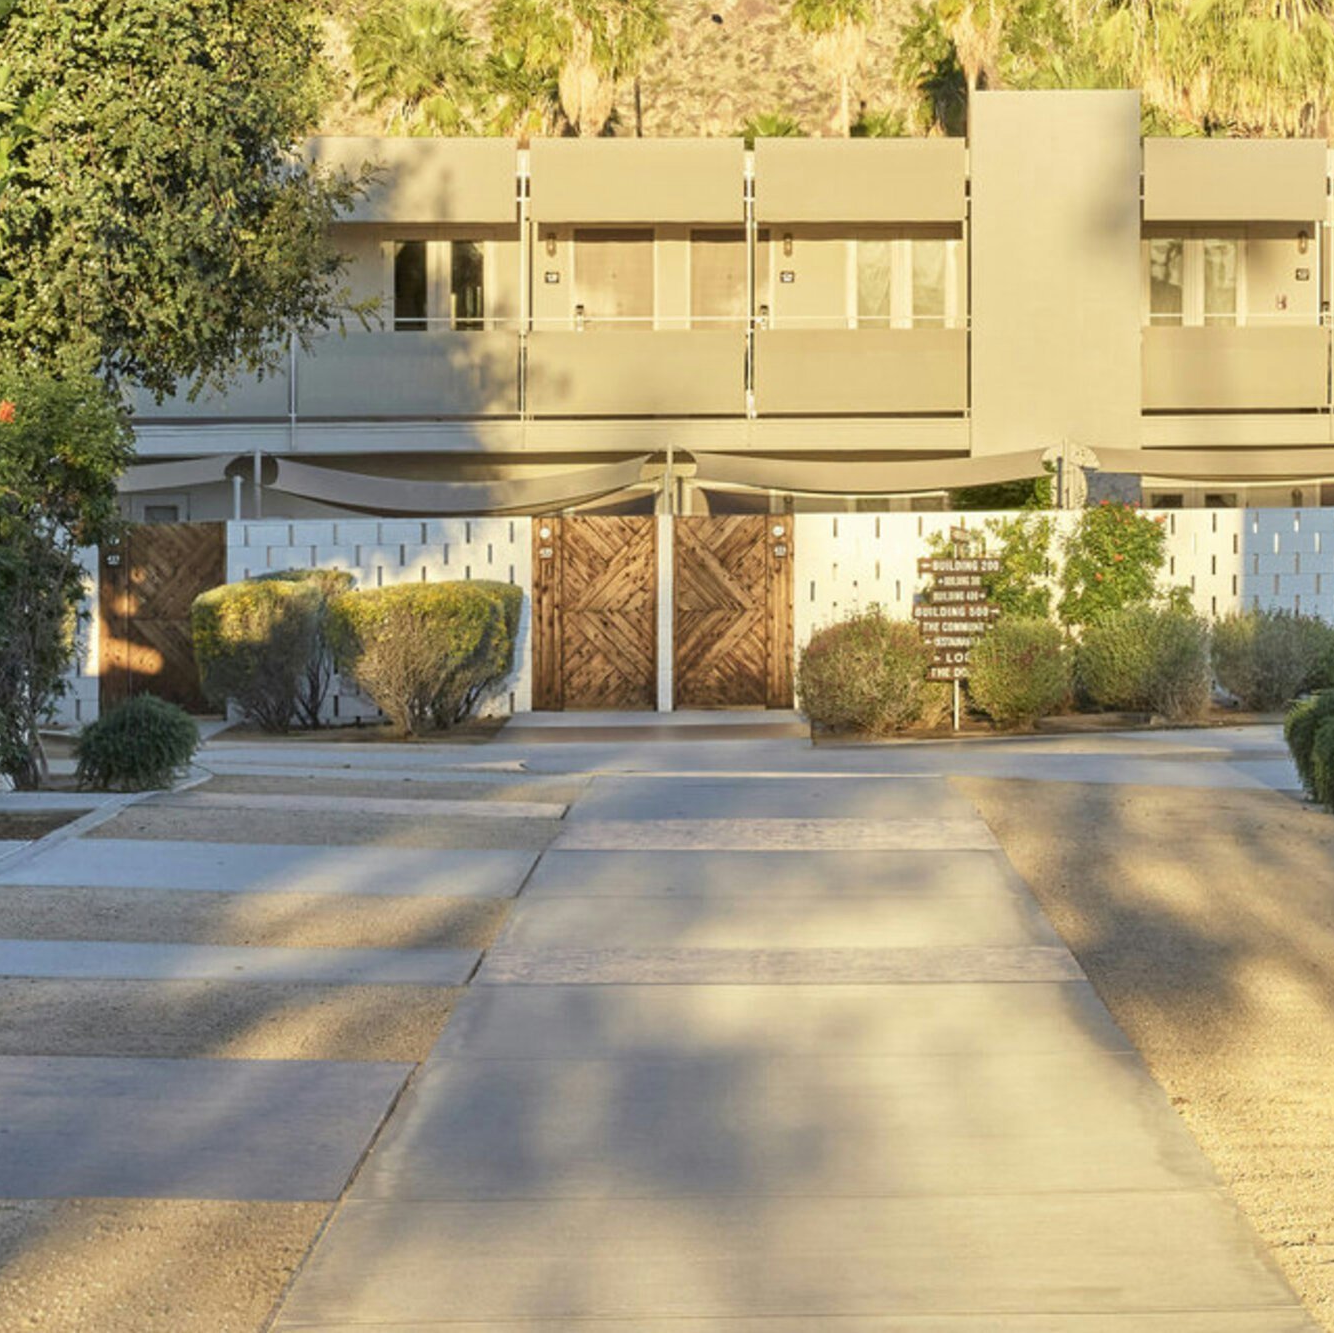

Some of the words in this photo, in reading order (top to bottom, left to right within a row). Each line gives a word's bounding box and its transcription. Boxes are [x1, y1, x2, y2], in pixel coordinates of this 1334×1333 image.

[932, 560, 978, 571] BUILDING
[981, 560, 999, 571] 200
[914, 606, 966, 617] BUILDING
[931, 667, 950, 678] THE
